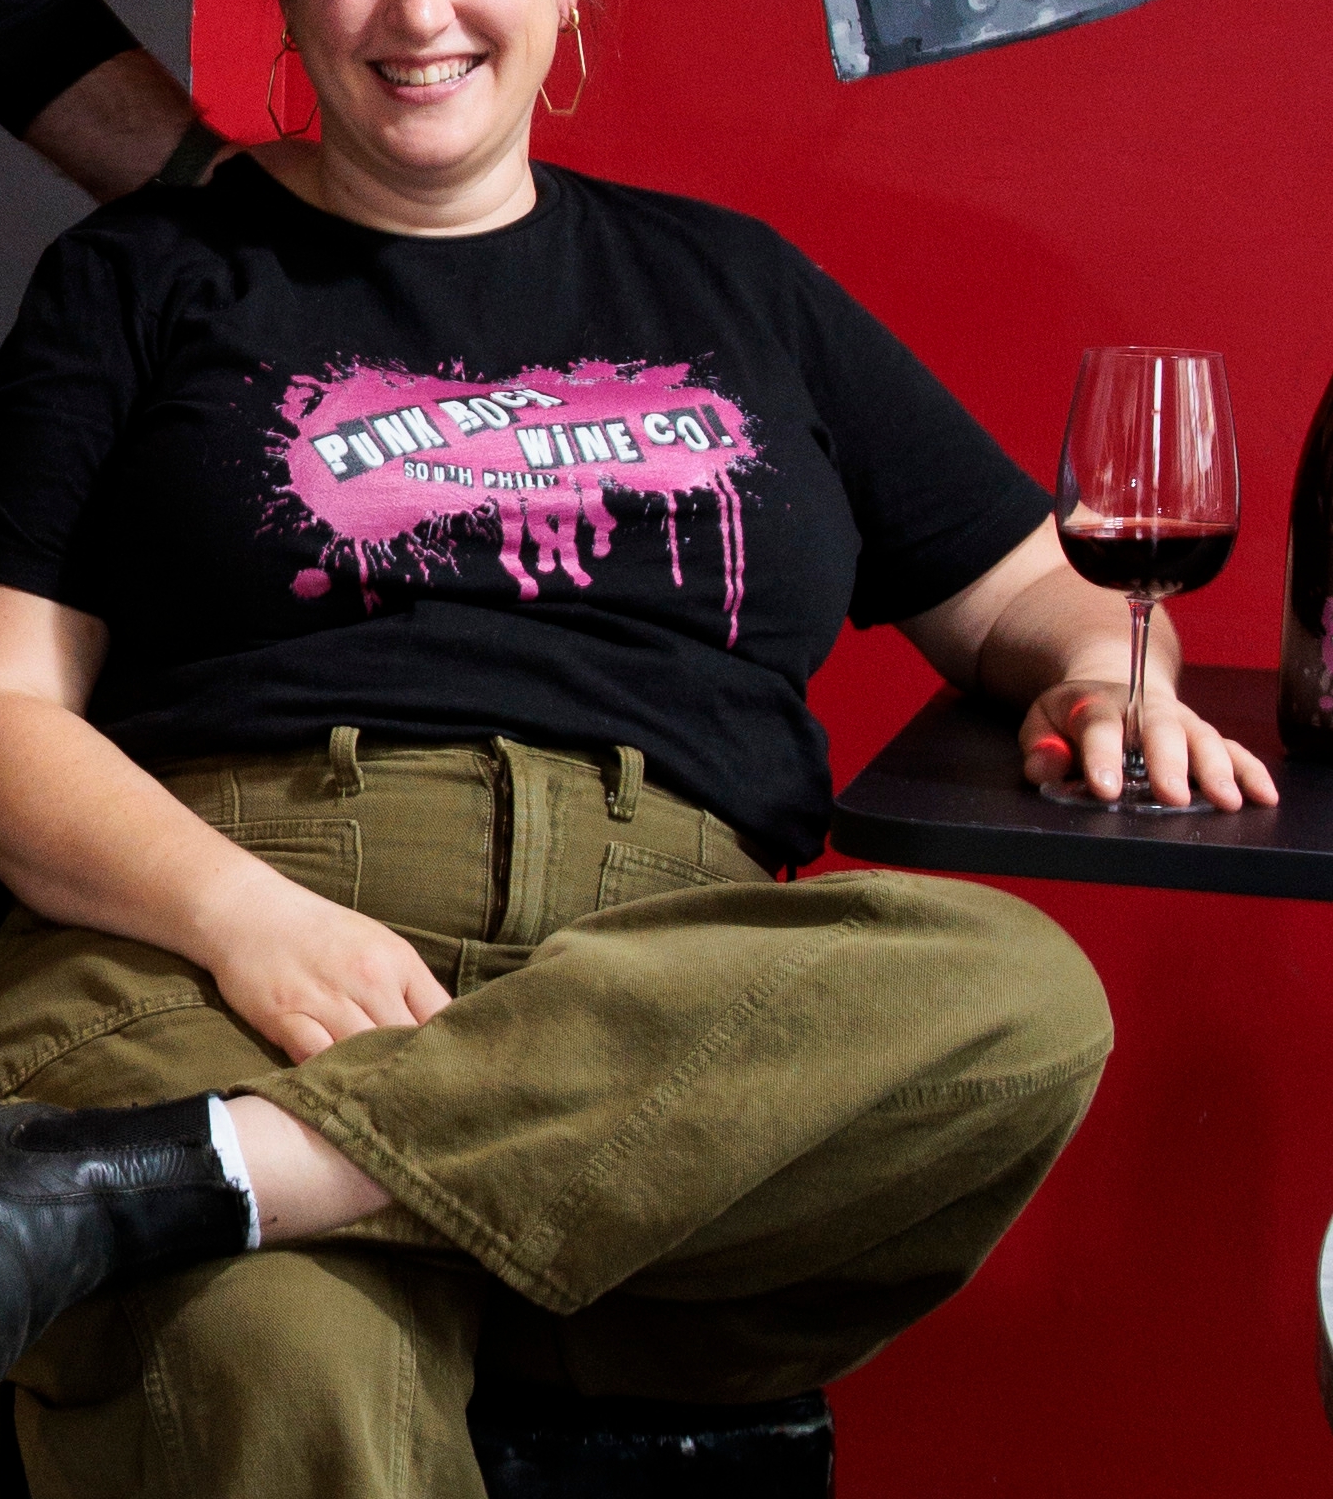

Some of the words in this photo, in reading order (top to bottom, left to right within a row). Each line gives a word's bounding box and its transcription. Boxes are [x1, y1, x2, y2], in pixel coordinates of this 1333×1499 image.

[312, 406, 445, 474] PUNK
[439, 388, 564, 433] ROCK
[404, 461, 474, 486] SOUTH
